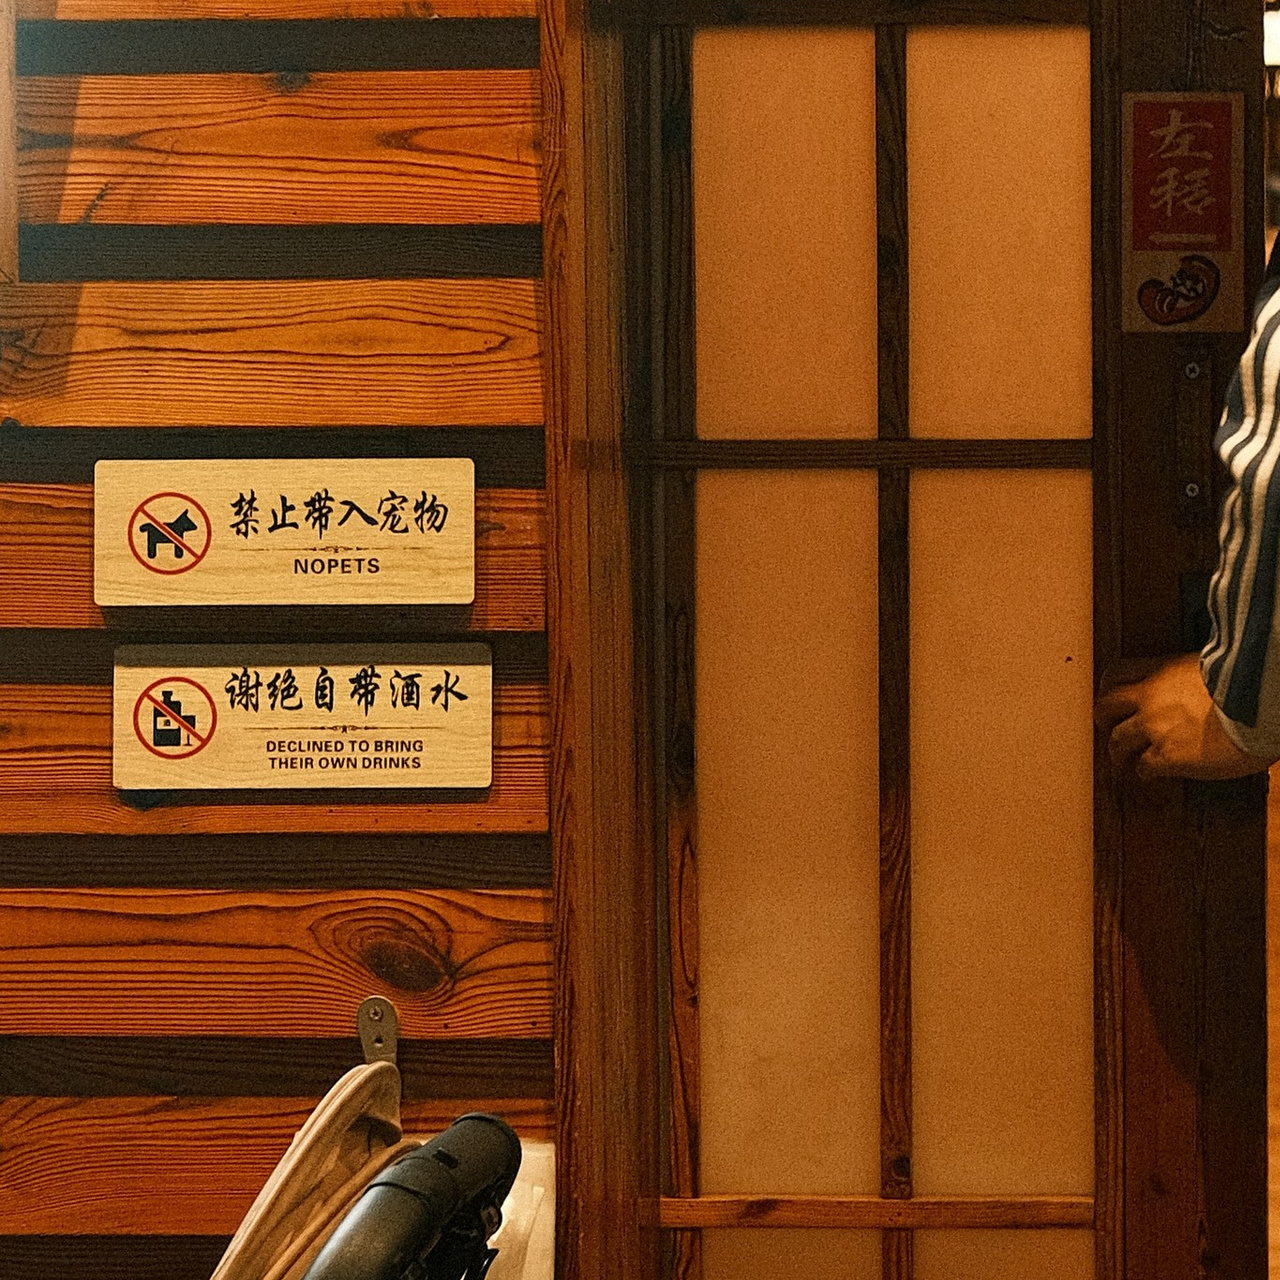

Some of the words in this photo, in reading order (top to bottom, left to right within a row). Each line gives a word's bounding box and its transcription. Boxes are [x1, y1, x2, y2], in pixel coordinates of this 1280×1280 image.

[229, 488, 449, 540] 禁止带入宠物
[294, 557, 381, 575] NOPETS
[224, 665, 469, 717] 谢绝自带酒水
[266, 740, 345, 753] DECLINED
[349, 740, 370, 753] TO
[374, 740, 424, 753] BRING
[269, 756, 314, 770] THEIR
[318, 756, 358, 770] OWN
[362, 756, 422, 770] DRINKS
